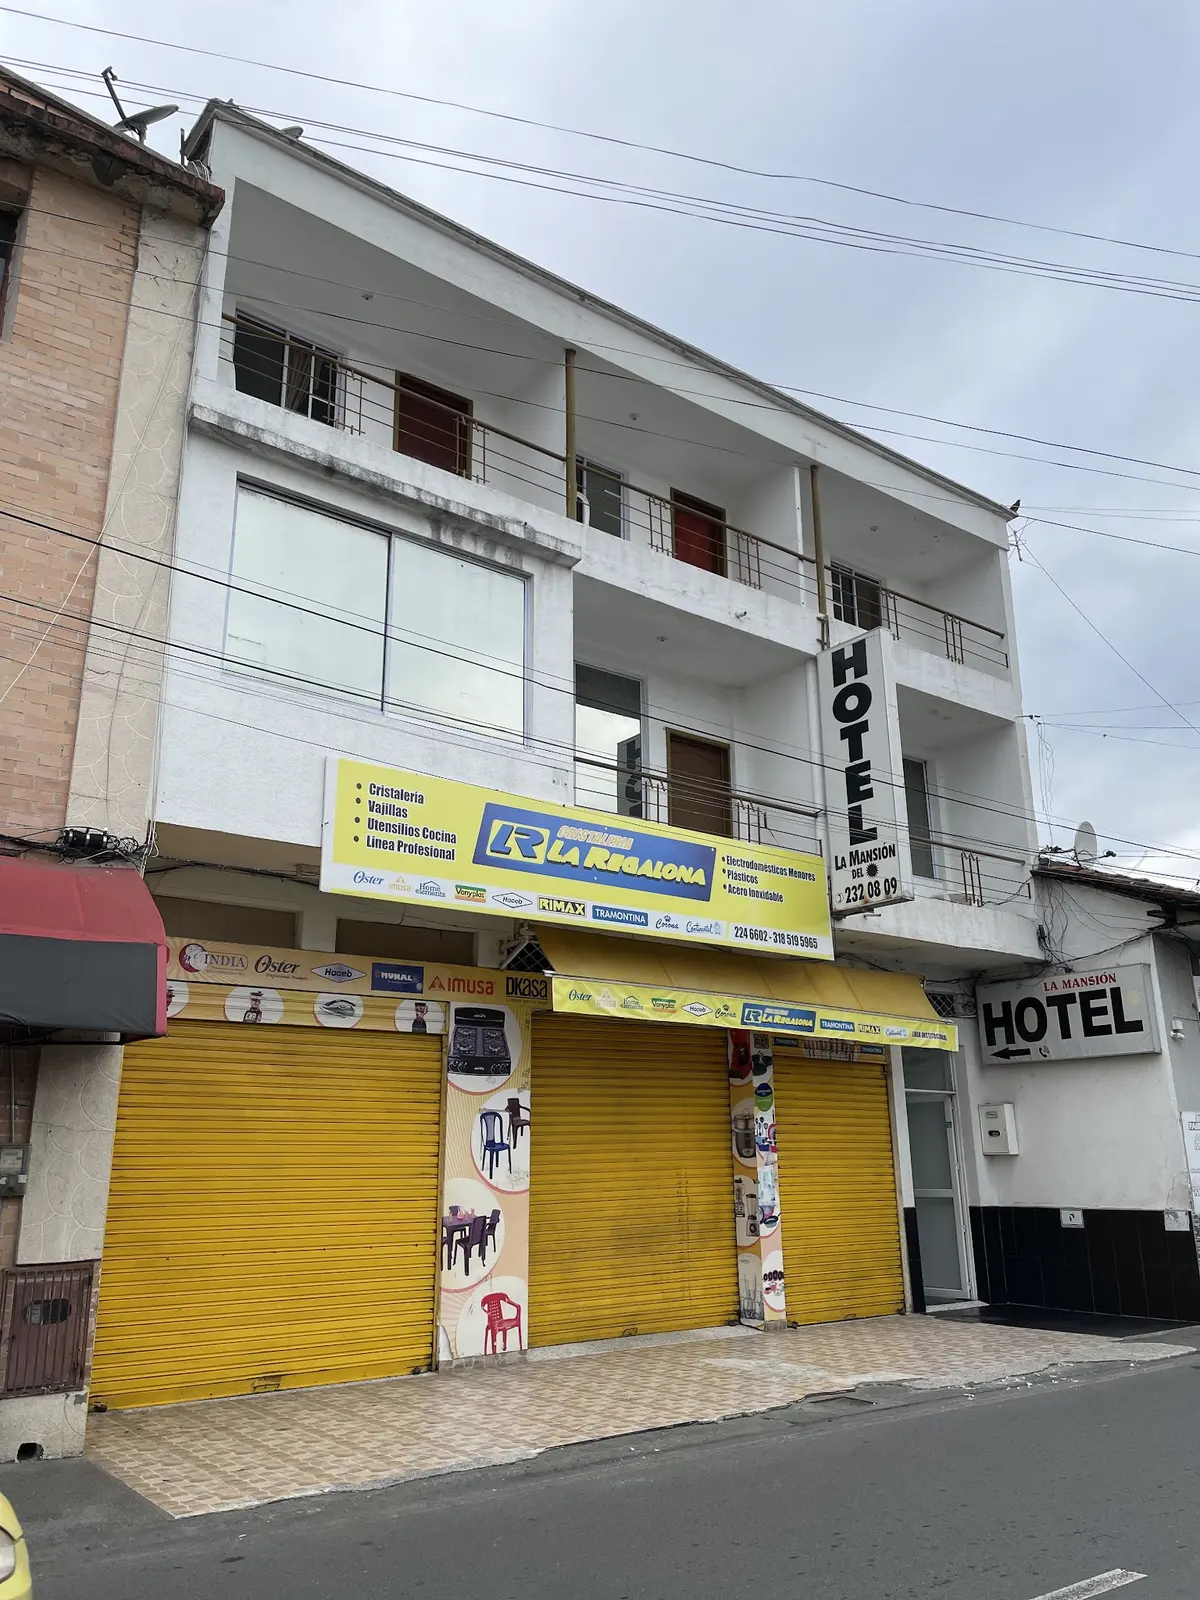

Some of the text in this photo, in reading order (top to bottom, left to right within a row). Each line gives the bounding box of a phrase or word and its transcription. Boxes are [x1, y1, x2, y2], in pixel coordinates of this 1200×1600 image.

[831, 639, 878, 846] HOTEL
[369, 782, 425, 805] Cristalería
[367, 800, 408, 819] Vajillas
[367, 817, 457, 844] Utensilios Cocina
[366, 834, 455, 861] Linea Profesional
[834, 842, 896, 871] LA MANSIÓN
[546, 839, 706, 887] LA REGALONA
[726, 855, 816, 882] Electrodomésticos Menores
[852, 867, 864, 879] DEL
[353, 870, 384, 886] Oster
[727, 869, 759, 885] Plásticos
[415, 888, 446, 898] elements
[420, 882, 441, 893] Home
[728, 883, 784, 903] Acero Inoxidable
[845, 877, 897, 903] 232 08 09
[538, 897, 586, 917] RIMAX
[595, 908, 646, 924] TRAMONTINA
[655, 919, 679, 930] Corona
[734, 926, 749, 939] 224
[749, 928, 768, 942] 6602
[773, 931, 786, 944] 318
[786, 933, 799, 946] 519
[800, 936, 818, 949] 5965
[204, 953, 245, 968] INDIA
[254, 954, 301, 974] Oster
[325, 968, 353, 978] Haceb
[1044, 971, 1117, 992] LA MANSIÓN
[568, 988, 593, 1002] Oster
[822, 1020, 854, 1031] TRAMONTINA
[982, 986, 1144, 1047] HOTEL
[858, 1024, 880, 1034] RIMAX
